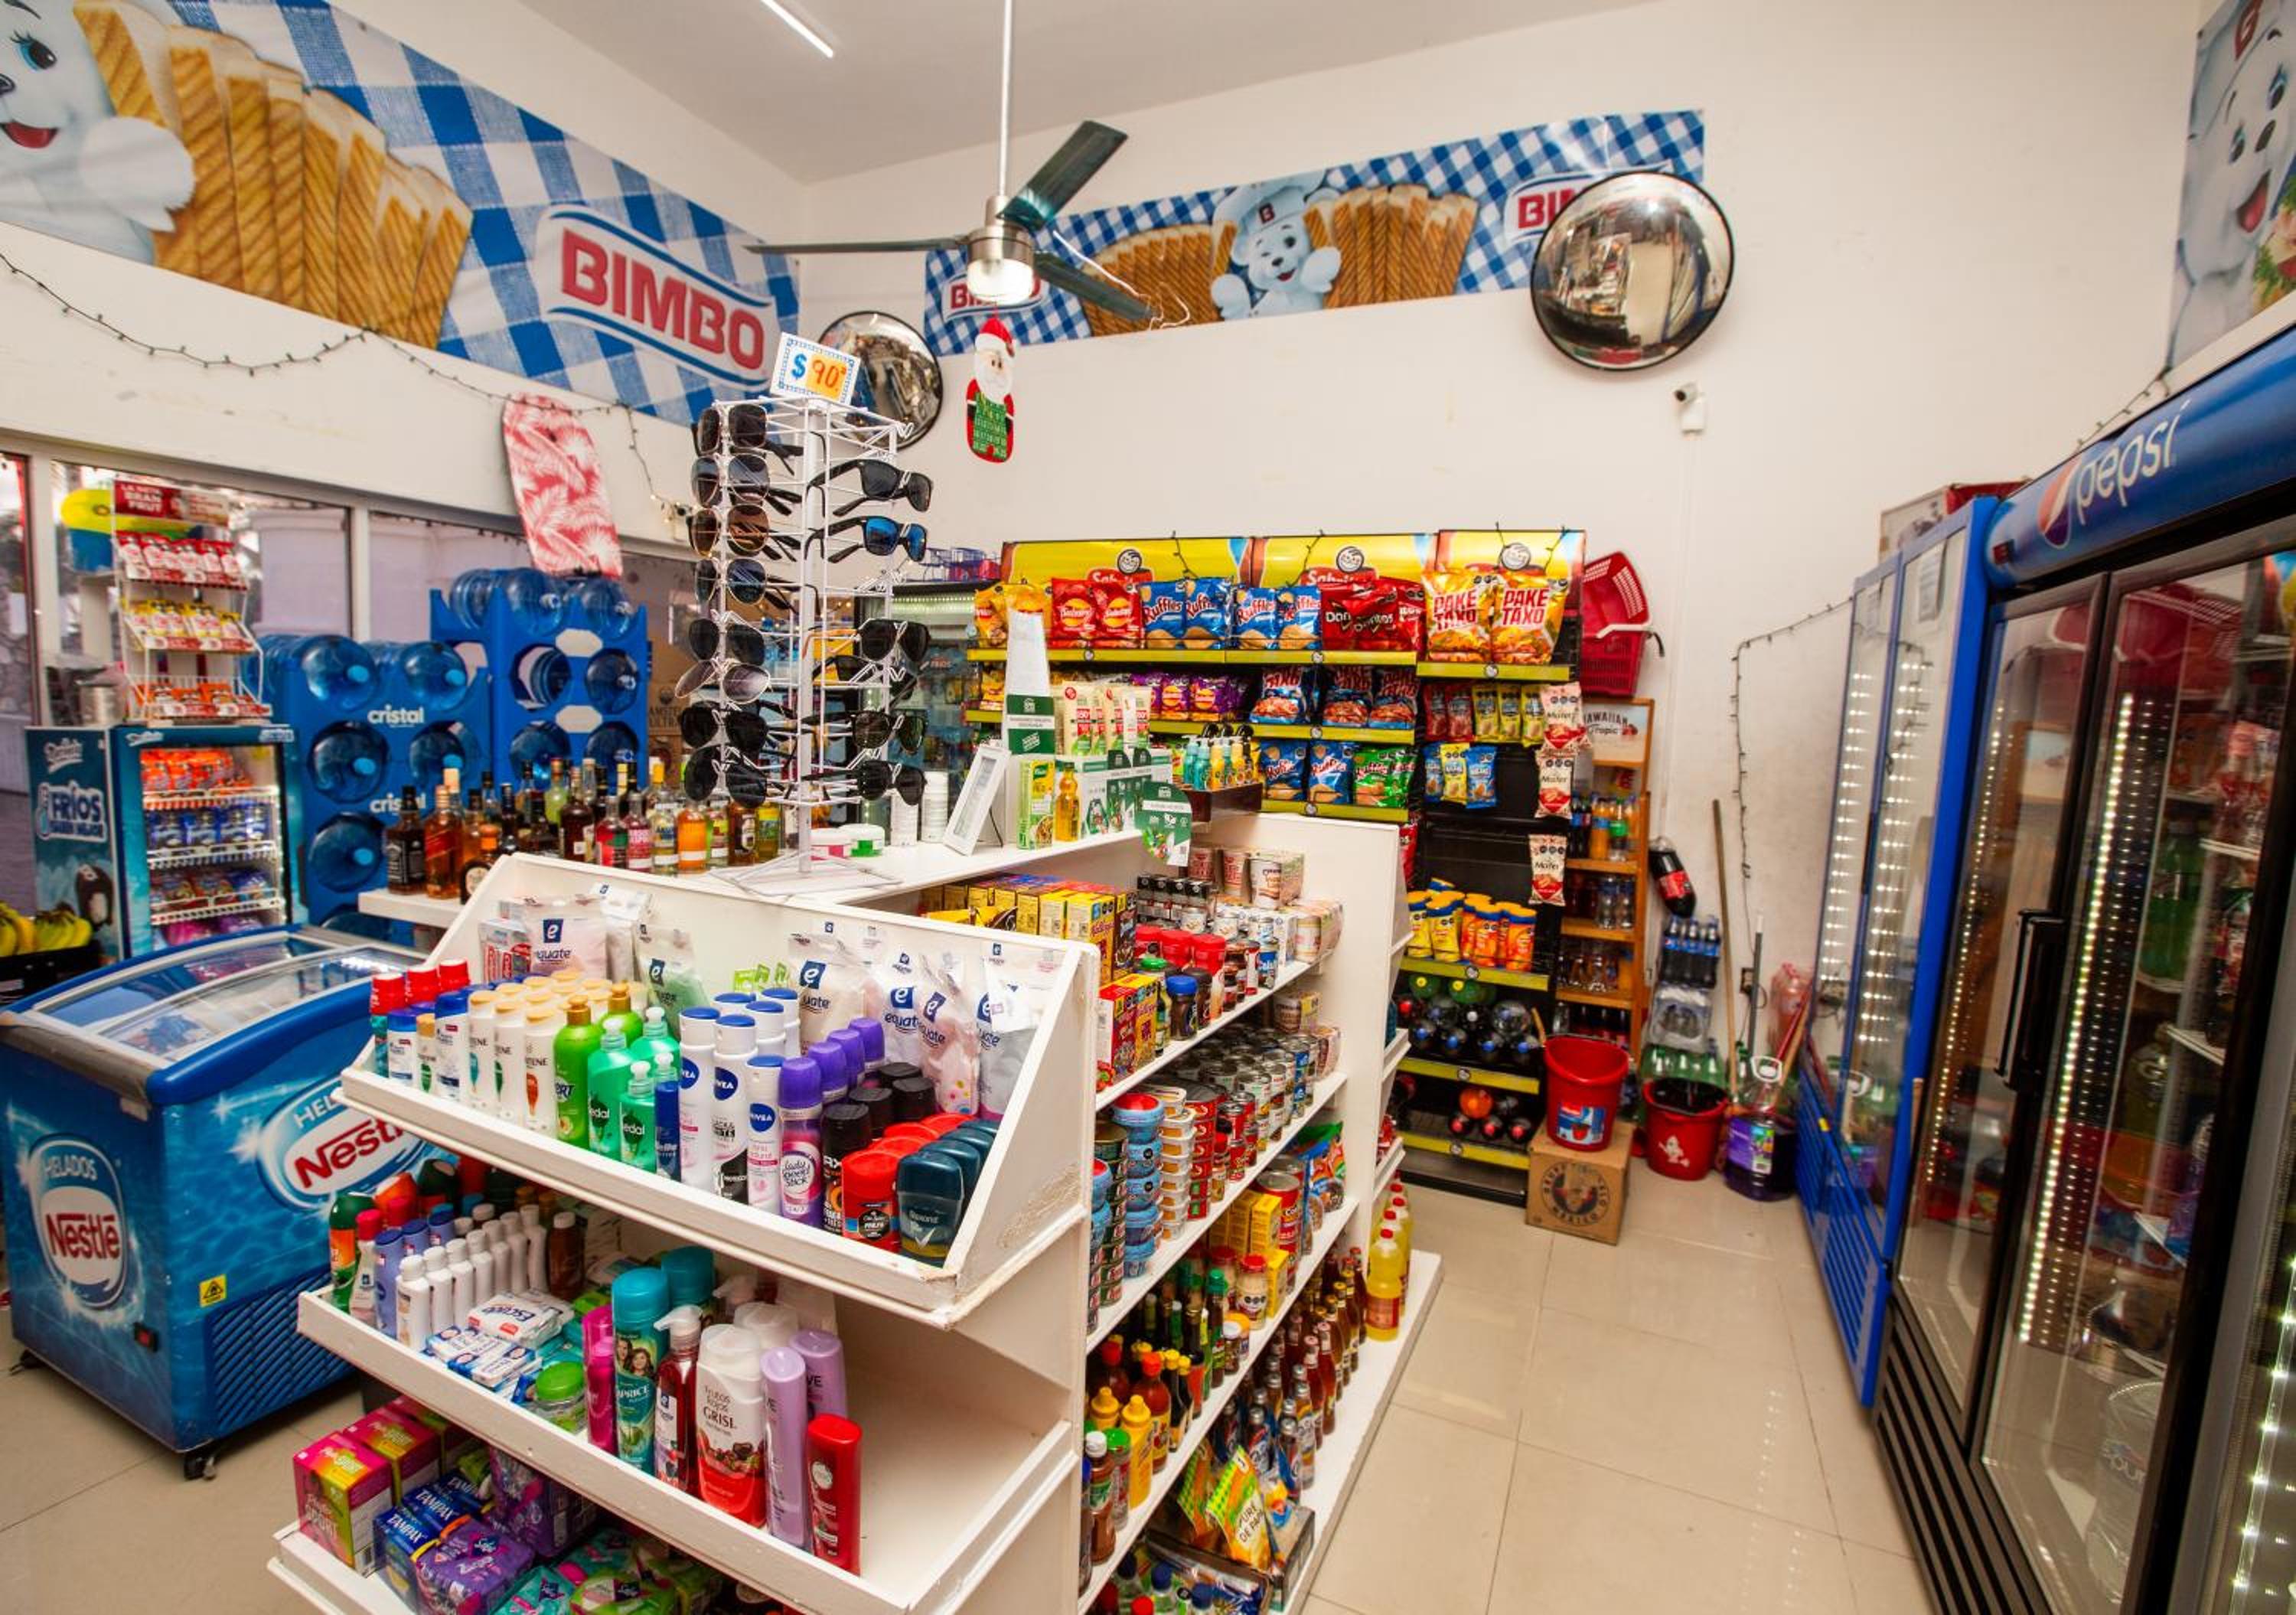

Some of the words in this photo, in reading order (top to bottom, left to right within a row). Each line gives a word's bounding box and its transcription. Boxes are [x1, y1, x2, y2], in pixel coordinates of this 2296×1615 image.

[559, 229, 765, 370] BIMBO
[2073, 400, 2192, 525] pepsi
[1504, 589, 1549, 607] PAKE
[367, 704, 424, 724] cristal
[370, 792, 426, 814] crisl
[536, 948, 572, 962] quate
